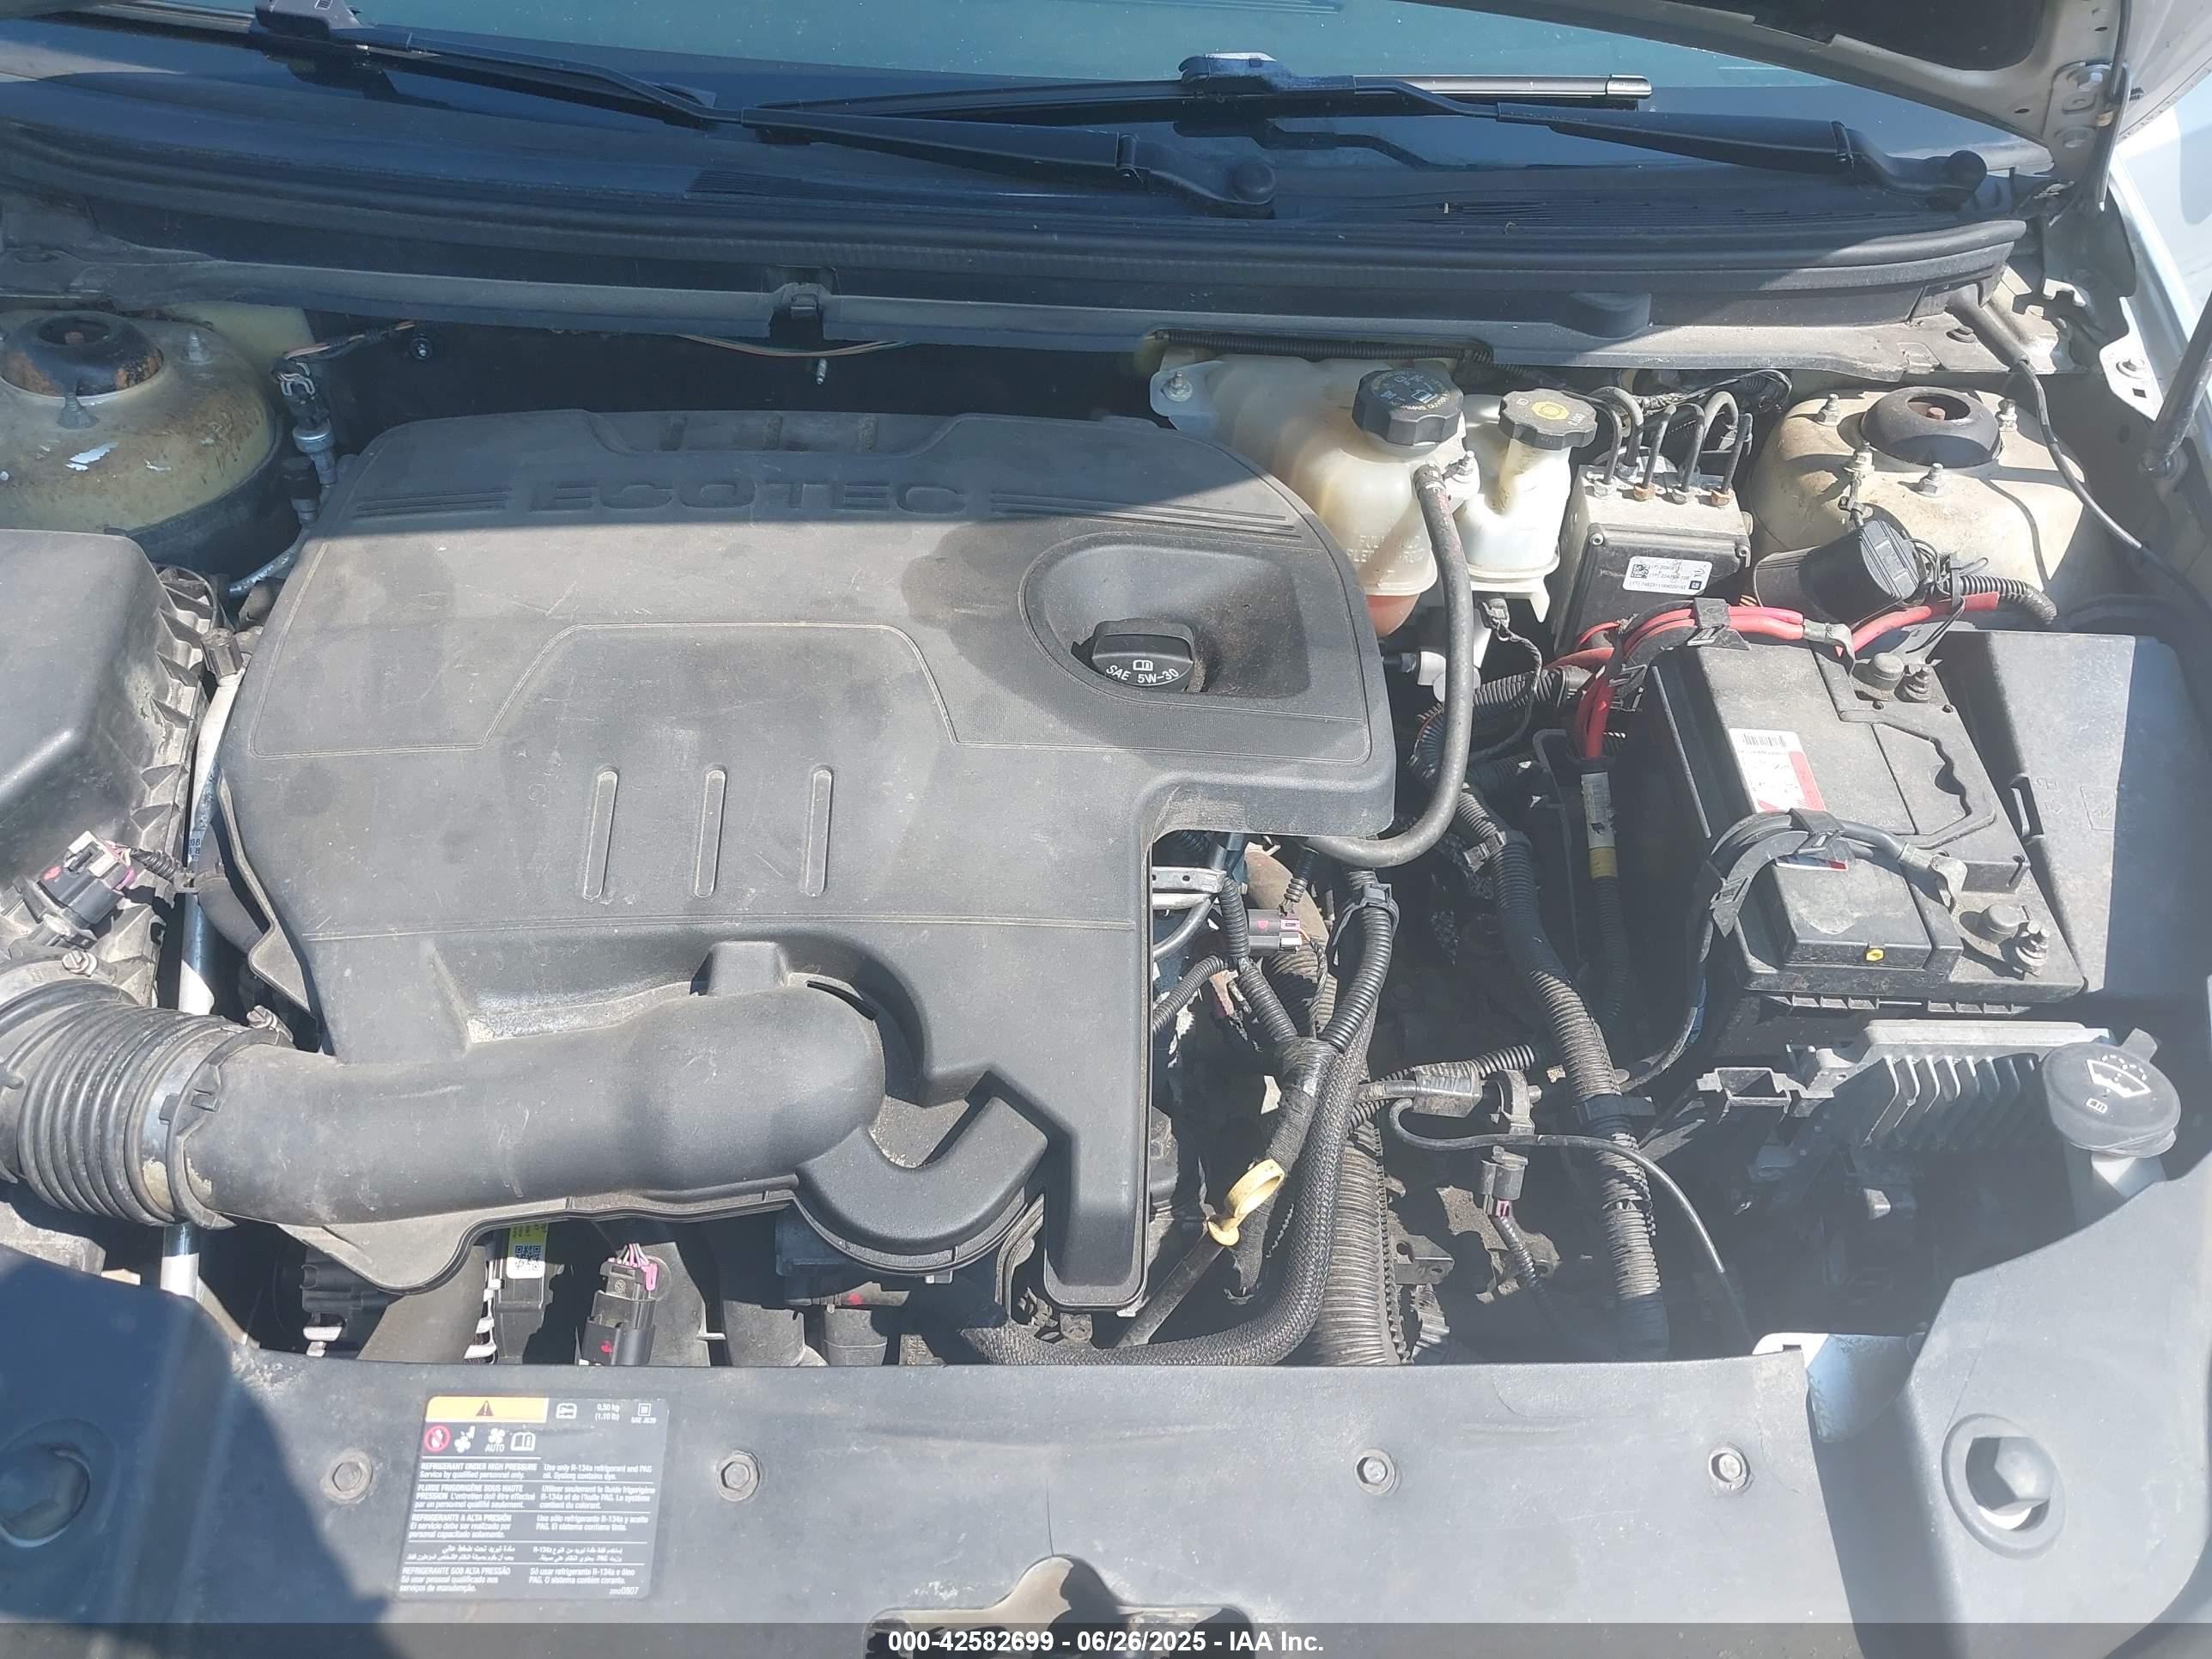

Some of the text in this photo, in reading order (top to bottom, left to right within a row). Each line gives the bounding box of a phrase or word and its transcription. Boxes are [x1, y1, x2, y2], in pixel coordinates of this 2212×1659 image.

[529, 480, 967, 514] ECOTEC
[1105, 665, 1180, 684] SAE 5W-30
[484, 1443, 505, 1452] AUTO
[556, 1464, 570, 1473] only
